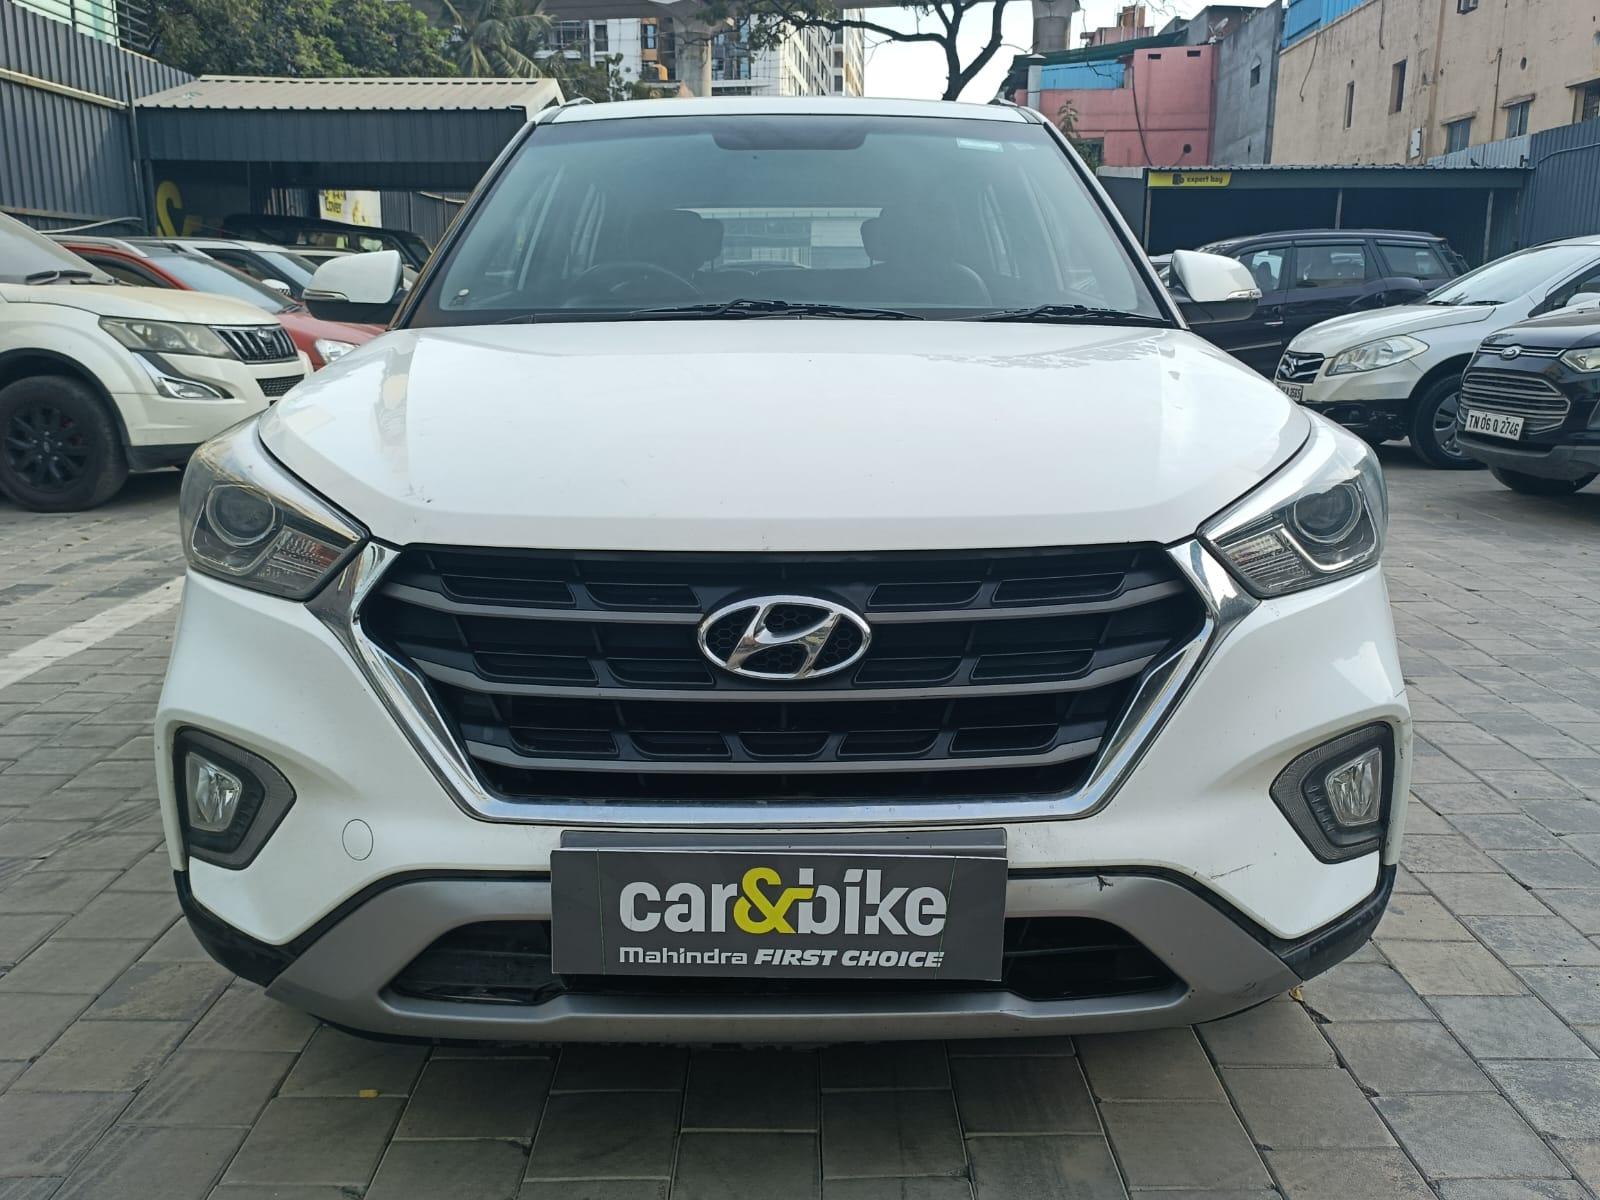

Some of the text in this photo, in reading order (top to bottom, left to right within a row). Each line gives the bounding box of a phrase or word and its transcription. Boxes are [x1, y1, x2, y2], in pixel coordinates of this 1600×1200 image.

[1187, 176, 1209, 184] expert
[1469, 414, 1519, 437] TN 06 Q 2746
[619, 866, 948, 937] car&bike
[619, 946, 945, 968] Mahindra FIRST CHOICE
